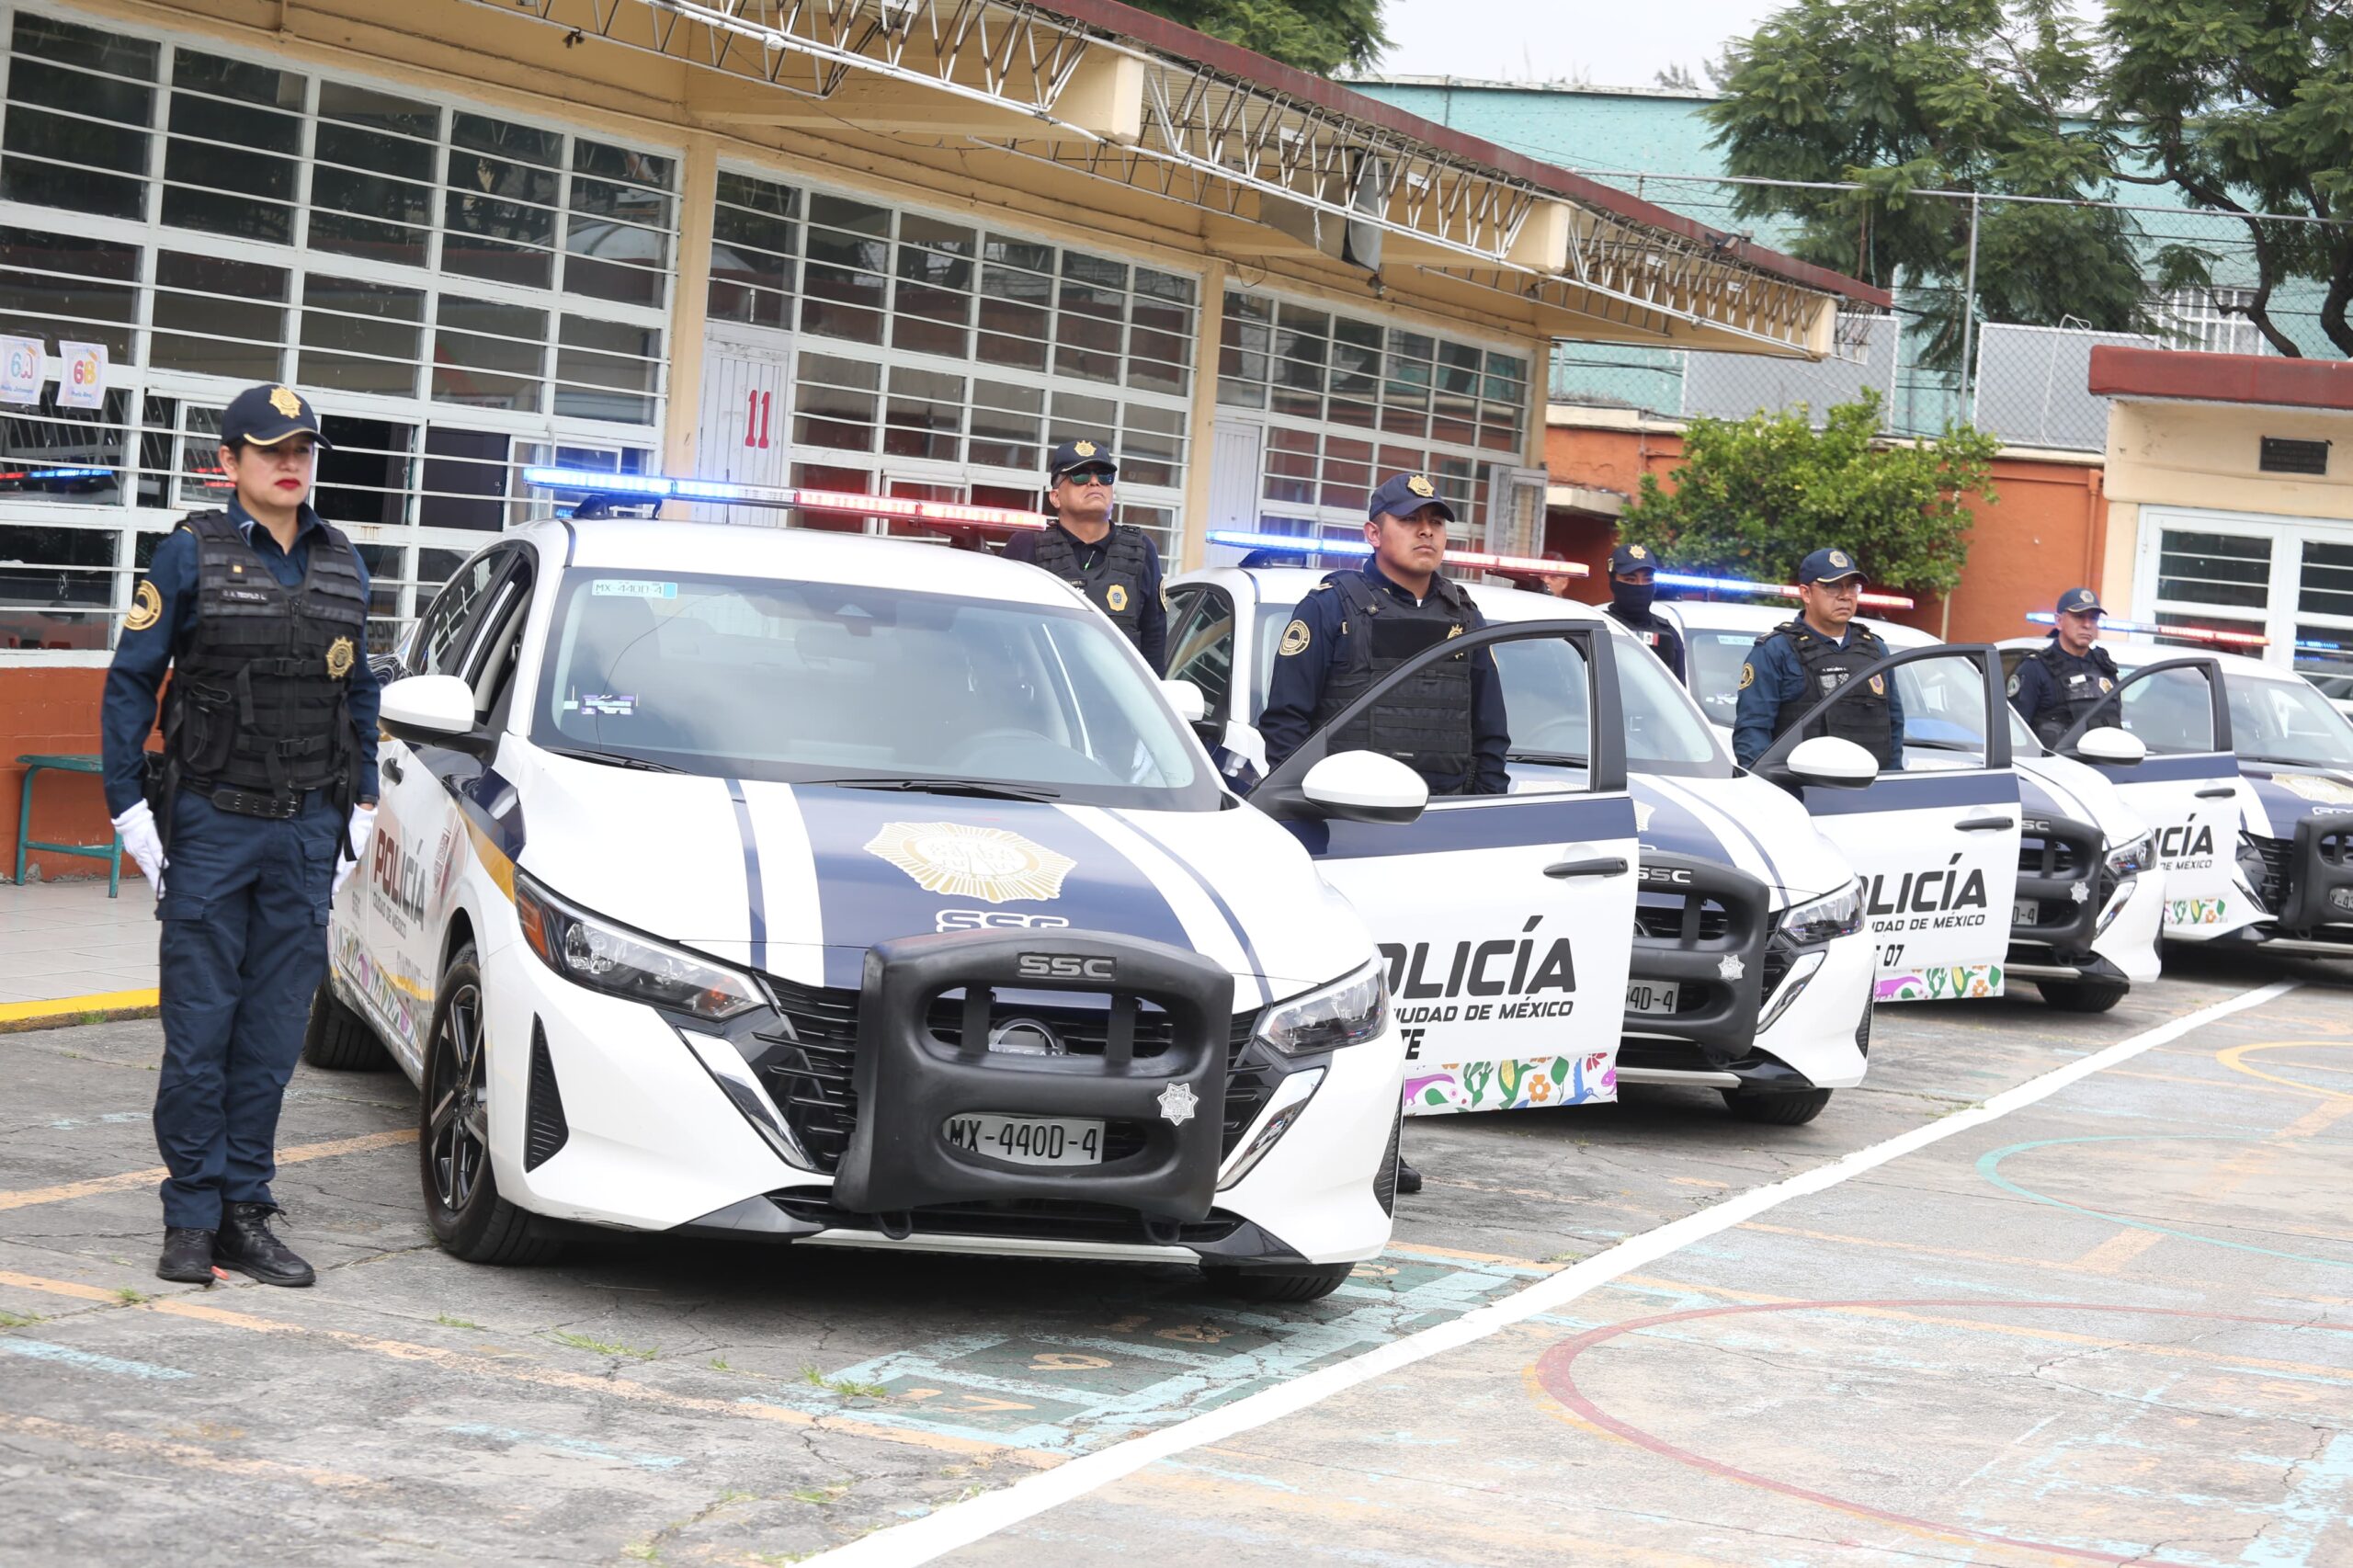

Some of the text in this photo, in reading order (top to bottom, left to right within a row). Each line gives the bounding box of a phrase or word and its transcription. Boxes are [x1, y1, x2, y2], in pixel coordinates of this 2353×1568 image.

[74, 359, 97, 384] 6B
[745, 389, 770, 449] 11
[374, 827, 426, 933] POLICÍA
[1909, 918, 1929, 931] DE
[1933, 911, 1986, 929] MÉXICO
[1020, 955, 1113, 978] SSC
[1376, 915, 1577, 1000] OLICÍA
[1883, 944, 1904, 967] 07
[1394, 996, 1574, 1024] IUDAD DE MÉXICO
[949, 1118, 1098, 1161] MX-440D-4
